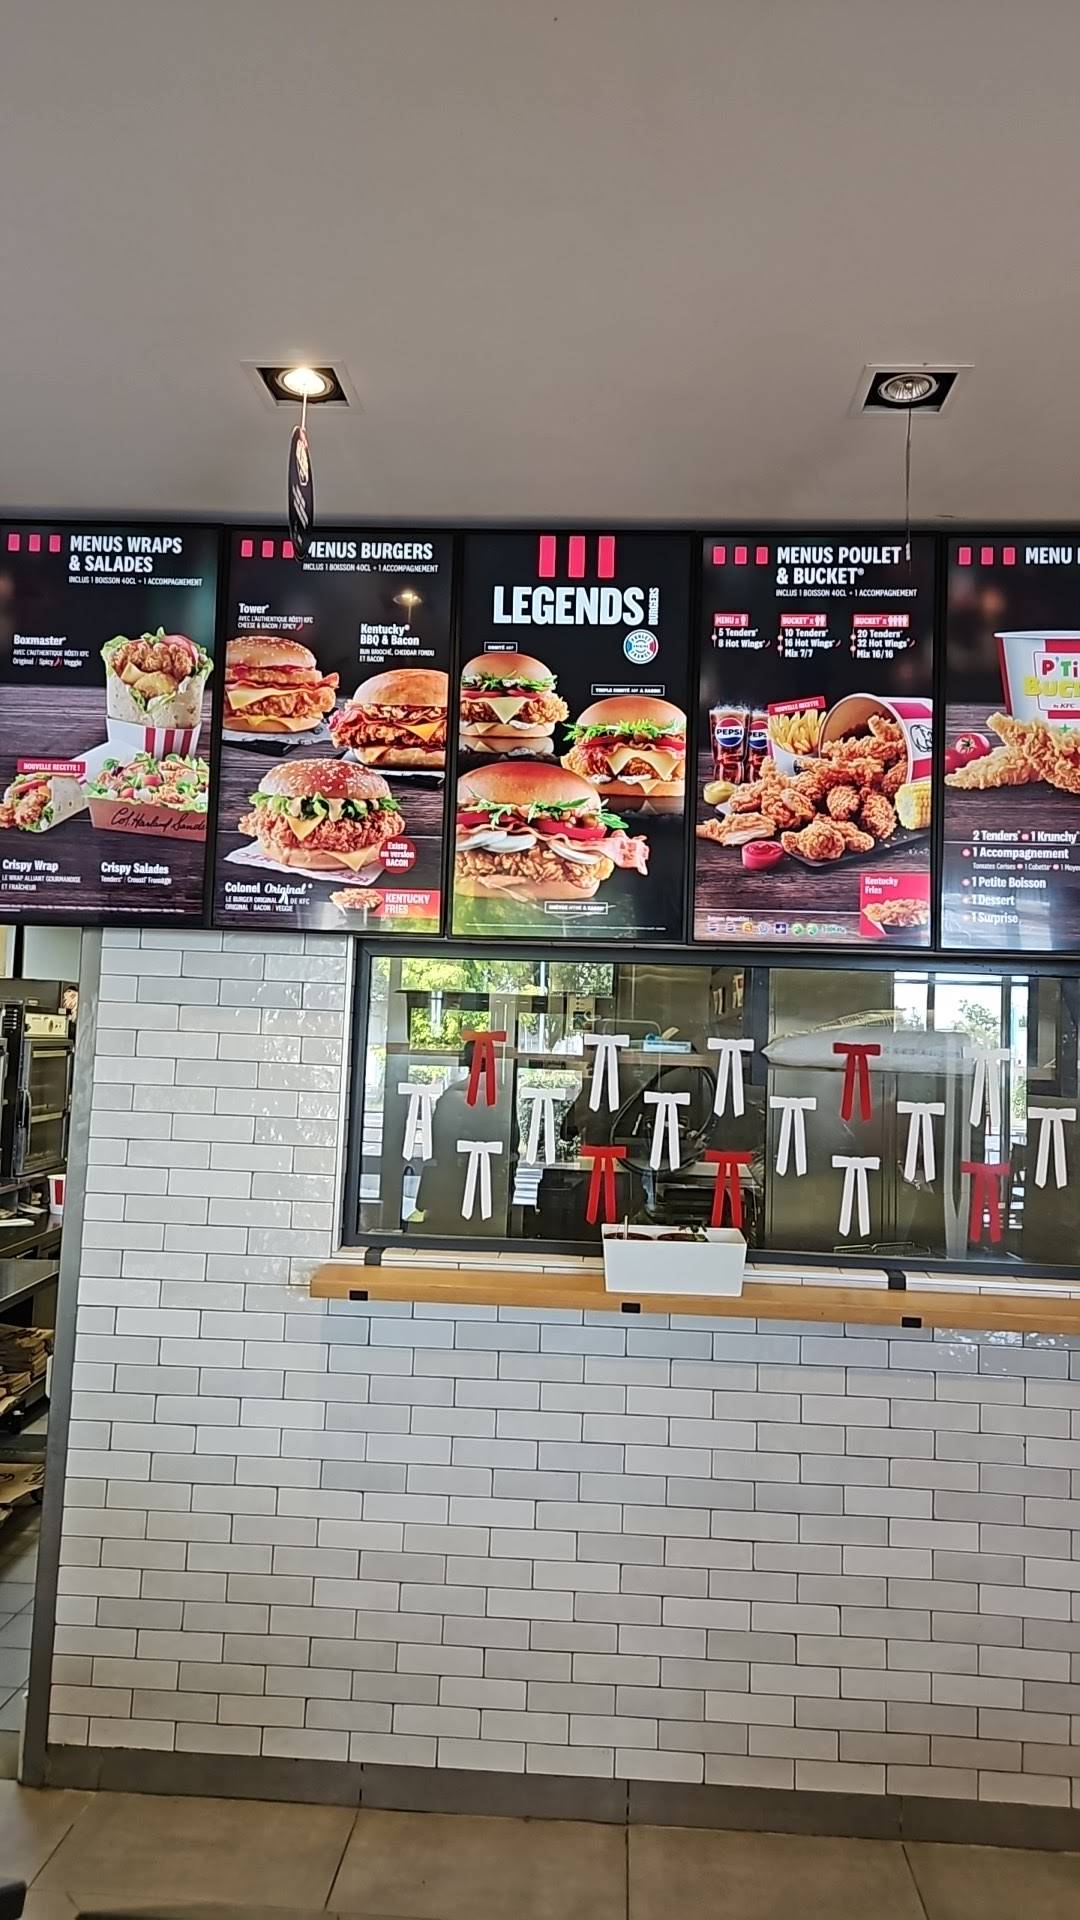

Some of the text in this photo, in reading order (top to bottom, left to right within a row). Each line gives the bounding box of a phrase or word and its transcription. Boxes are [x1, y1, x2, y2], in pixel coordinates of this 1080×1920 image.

[70, 535, 183, 554] MENUS WRAPS
[361, 542, 433, 560] BURGERS
[776, 546, 902, 564] MENUS POULET
[1025, 546, 1073, 565] MENU
[69, 555, 153, 573] & SALADES
[303, 563, 324, 571] INCLUS
[329, 563, 355, 572] BOISSON
[356, 564, 372, 572] 40CL
[382, 565, 439, 573] ACCOMPAGNEMENT
[68, 576, 90, 584] INCLUS
[95, 576, 121, 585] BOISSON
[122, 577, 137, 585] 40CL
[148, 578, 203, 587] ACCOMPAGNEMENT
[776, 567, 789, 585] &
[775, 589, 798, 597] INCLUS
[803, 589, 831, 597] BOISSON
[831, 589, 847, 597] 40CL
[858, 589, 918, 598] ACCOMPAGNEMENT
[493, 586, 645, 626] LEGENDS
[648, 587, 660, 626] BURGERS
[718, 628, 724, 637] 5
[784, 629, 794, 637] 10
[857, 629, 868, 638] 20
[360, 634, 420, 646] BBQ & Bacon
[718, 639, 724, 648] 8
[725, 639, 740, 648] Hot
[795, 639, 809, 648] Hot
[857, 639, 868, 648] 32
[868, 639, 883, 648] Hot
[366, 655, 385, 663] BACON
[784, 649, 814, 659] Mix 7/7
[856, 650, 894, 660] Mix 16/16
[12, 657, 83, 668] Original Spicy Veggie
[716, 728, 743, 736] PEPSI
[972, 830, 980, 841] 2
[1030, 831, 1036, 842] 1
[387, 842, 408, 850] Existe
[390, 850, 415, 858] version
[979, 847, 1069, 860] Accompagnement
[2, 859, 59, 873] Crispy Wrap
[100, 862, 169, 875] Crispy Salades
[385, 859, 409, 867] BACON
[972, 862, 996, 870] Tomates
[225, 882, 260, 893] Colonel
[865, 877, 899, 888] Kentucky
[978, 877, 1007, 888] Petite
[1008, 877, 1047, 889] Boisson
[865, 886, 883, 894] Fries
[385, 893, 431, 904] KENTUCKY
[978, 895, 1015, 906] Dessert
[384, 904, 409, 914] FRIES
[977, 912, 1019, 925] Surprise
